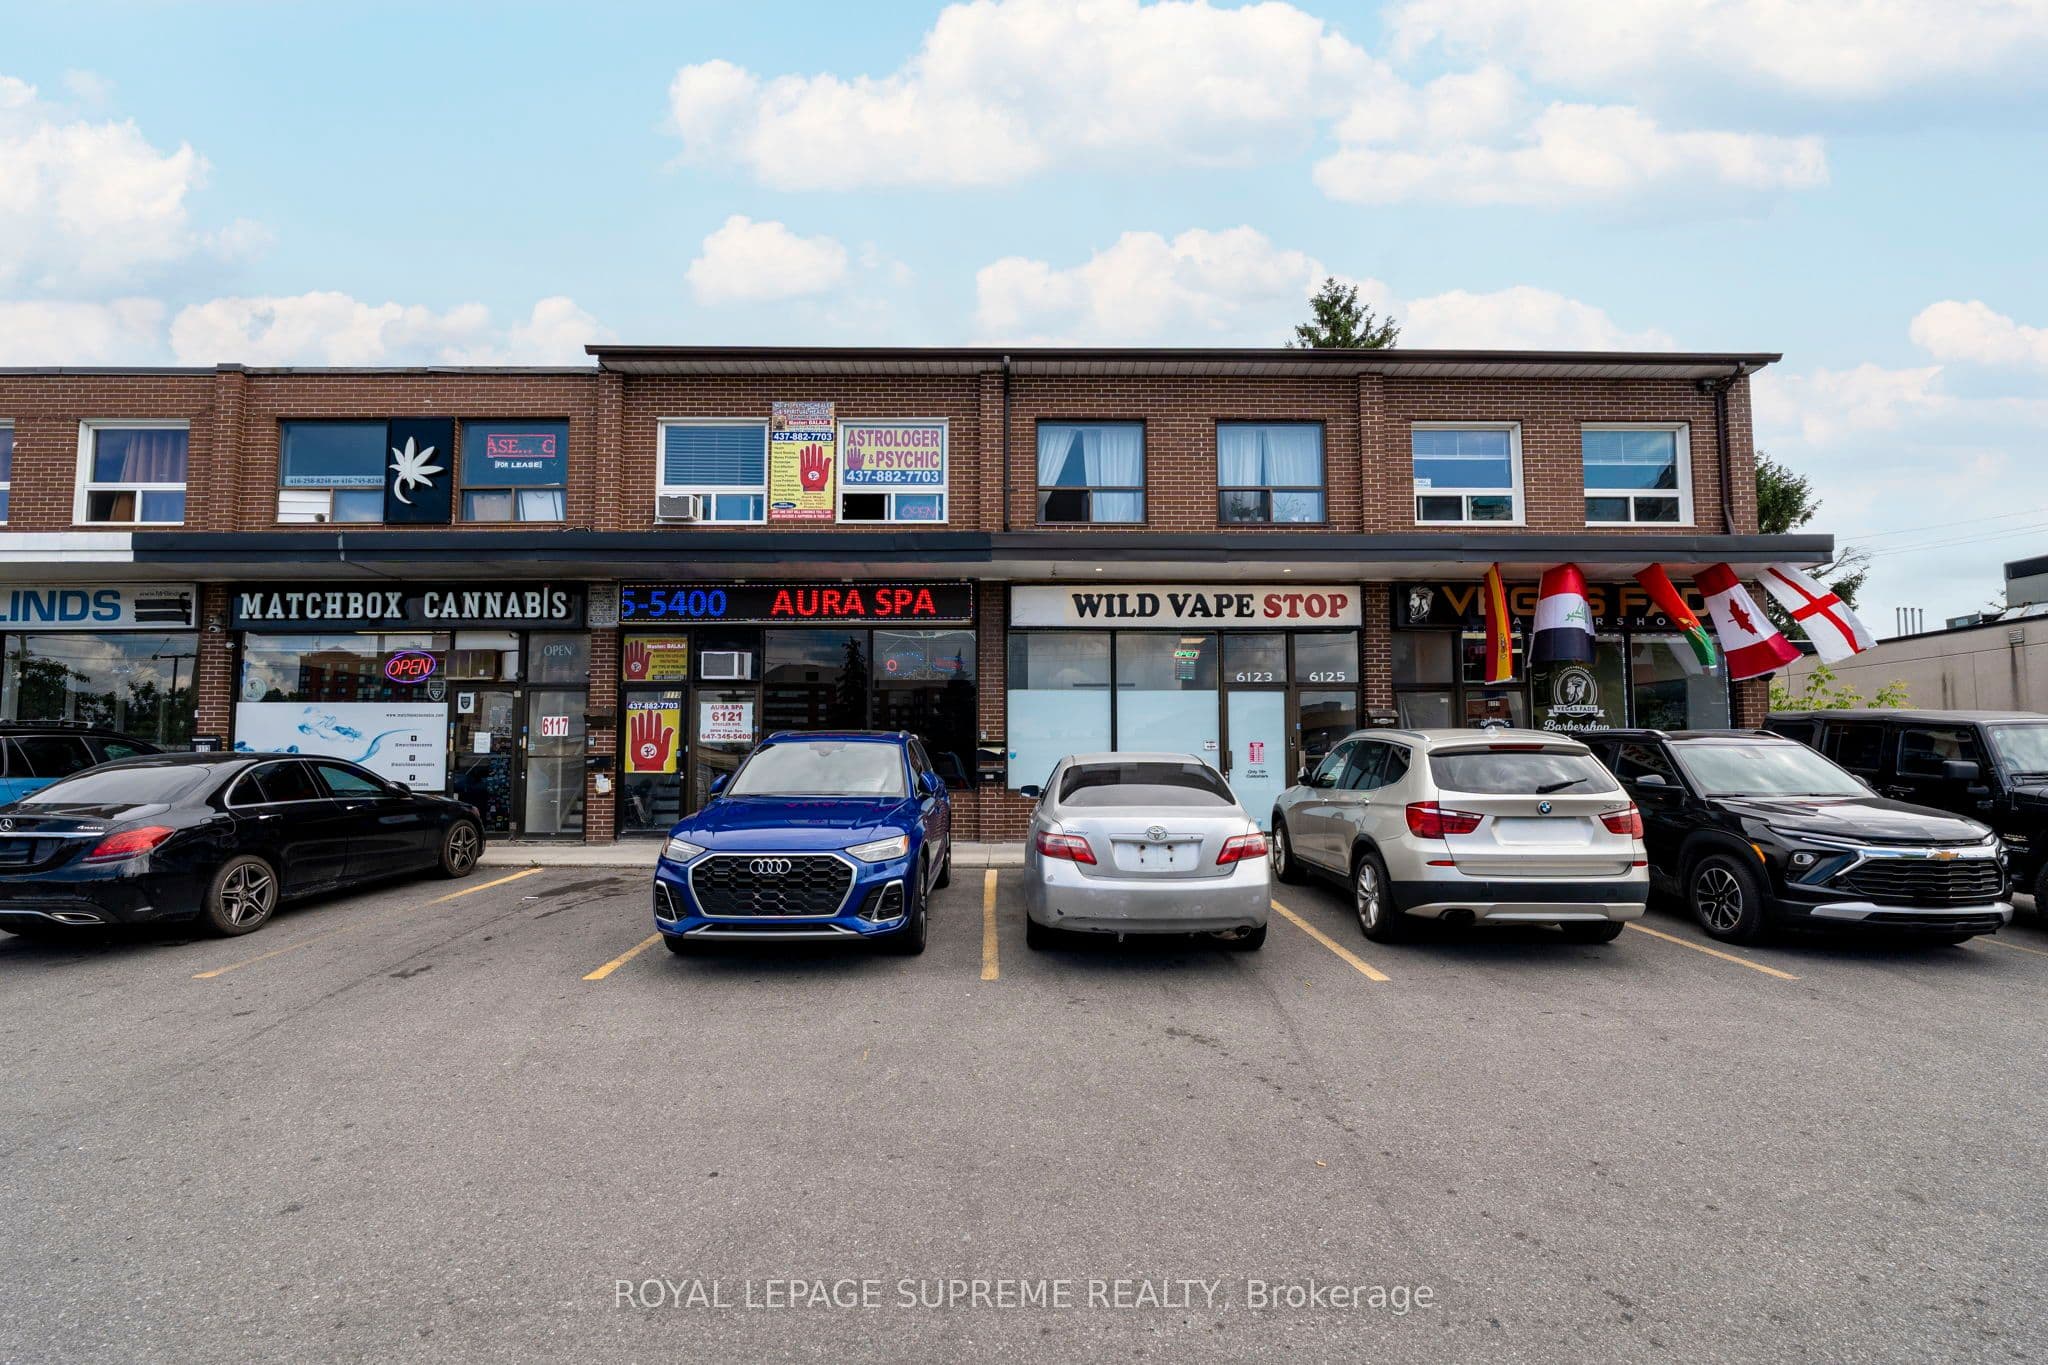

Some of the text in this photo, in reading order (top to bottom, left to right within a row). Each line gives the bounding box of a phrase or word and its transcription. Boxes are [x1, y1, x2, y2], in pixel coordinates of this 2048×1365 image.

[848, 430, 939, 447] ASTROLOGER
[868, 451, 939, 468] & PSYCHIC
[847, 471, 939, 482] 437-882-7703
[0, 590, 121, 621] INDS
[240, 592, 402, 619] MATCHBOX
[771, 590, 864, 616] AURA
[874, 589, 936, 615] SPA
[1072, 594, 1348, 618] WILD VAPE STOP
[544, 644, 571, 656] OPEN
[389, 657, 431, 676] OPEN
[1236, 672, 1273, 682] 6123
[1309, 671, 1346, 682] 6125
[712, 712, 743, 721] 6121
[542, 718, 569, 736] 6117
